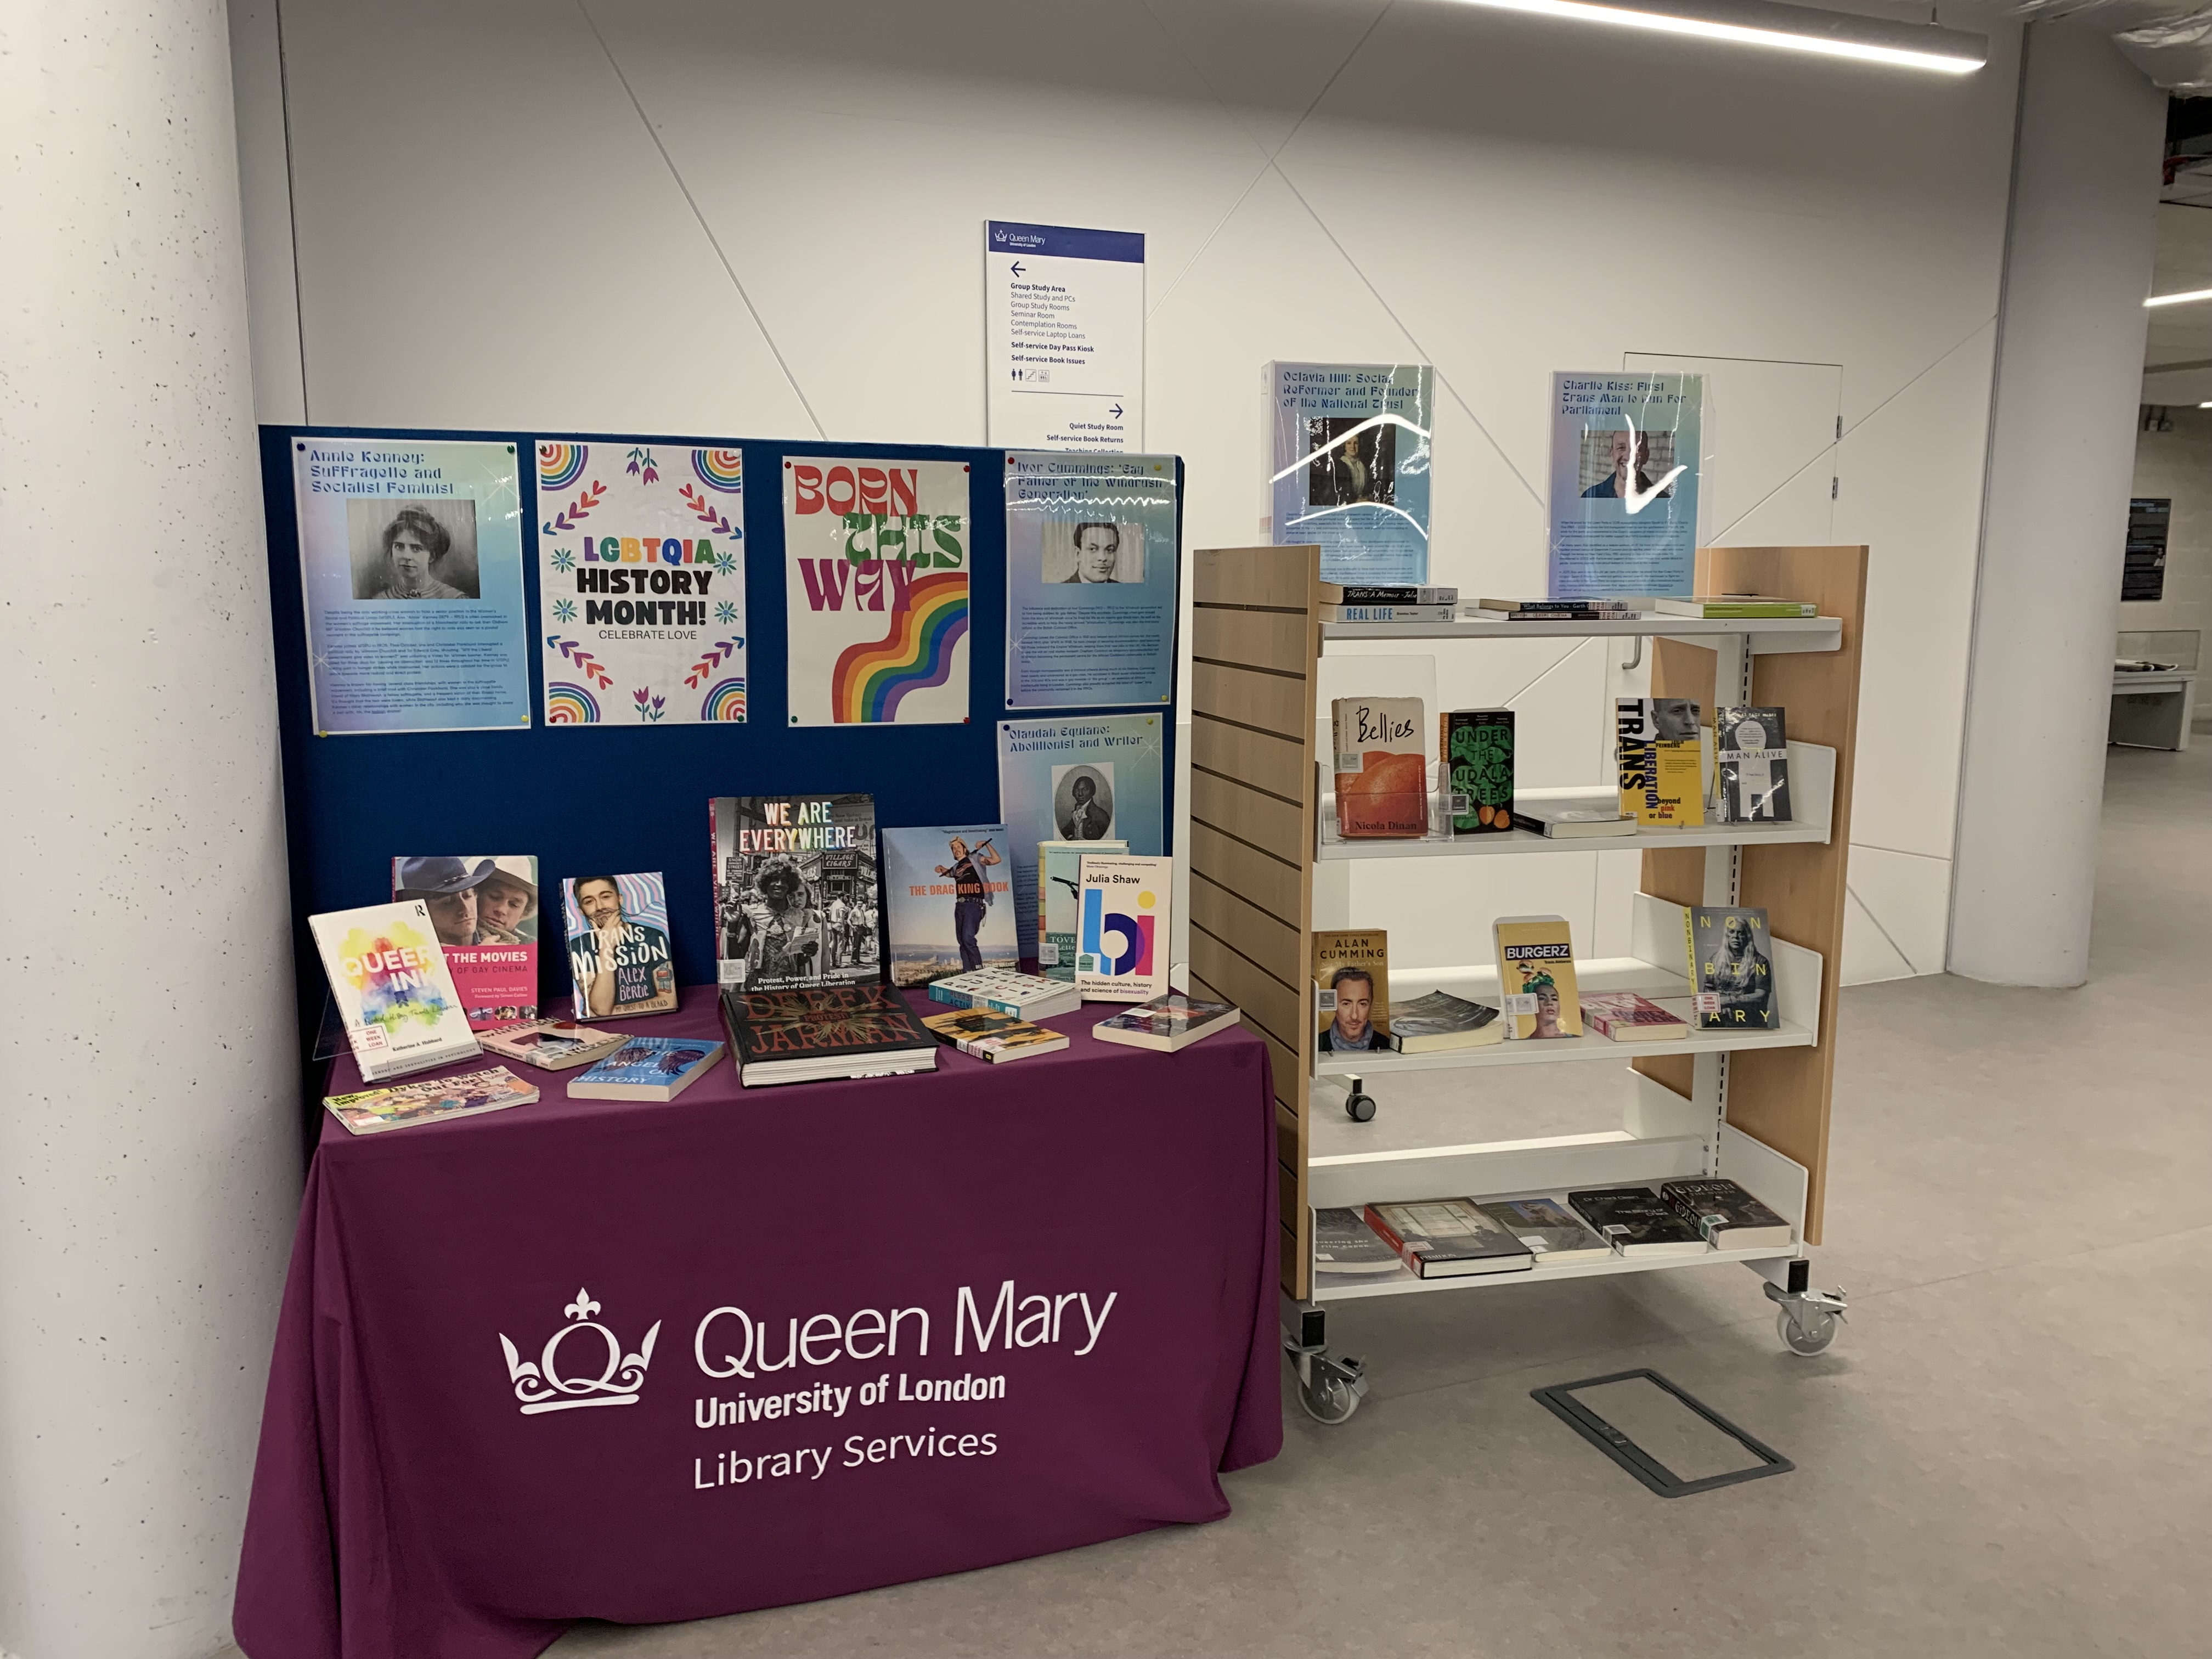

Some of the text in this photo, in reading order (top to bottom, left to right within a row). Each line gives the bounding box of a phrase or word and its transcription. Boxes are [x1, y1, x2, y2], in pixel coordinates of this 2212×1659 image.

[1009, 233, 1046, 245] Queen Mary
[1011, 283, 1030, 291] Group
[1032, 284, 1050, 292] Study
[1011, 291, 1032, 300] Shared
[1034, 293, 1051, 302] Study
[1011, 301, 1029, 309] Group
[1031, 302, 1048, 311] Study
[1011, 319, 1056, 328] Contemplation
[1011, 329, 1045, 337] Self-service
[1046, 330, 1067, 339] Laptop
[1011, 341, 1048, 349] Self-service
[1011, 354, 1048, 363] Self-service
[1284, 371, 1351, 383] Octavia Hill:
[1345, 386, 1365, 396] and
[1563, 380, 1664, 391] Charlie Kiss: First
[1301, 398, 1368, 409] the National
[1563, 393, 1637, 403] Trans Man to
[1562, 404, 1621, 415] Parliament
[311, 450, 425, 465] Annie Kenney:
[414, 468, 441, 479] and
[1018, 462, 1114, 475] Ivor Cummings:
[312, 481, 453, 494] Socialist Feminist
[794, 465, 918, 517] BORN
[843, 512, 963, 569] THIS
[584, 537, 715, 566] LGBTQIA
[576, 567, 713, 595] HISTORY
[797, 558, 918, 612] WAY
[585, 599, 706, 626] MONTH!
[1346, 607, 1393, 620] REAL LIFE
[599, 630, 697, 640] CELEBRATE LOVE
[1356, 706, 1414, 743] Bellies
[1009, 725, 1110, 740] Olaudah Equiano:
[1455, 729, 1509, 744] UNDER
[1010, 735, 1143, 752] Abolitionist and Writer
[1618, 699, 1646, 790] TRANS
[1471, 749, 1494, 761] THE
[1726, 750, 1783, 760] MAN ALIVE
[1455, 769, 1509, 782] UDALA
[1644, 740, 1658, 809] LIBERATION
[1455, 786, 1509, 801] TREES
[1657, 797, 1681, 806] beyond
[764, 802, 833, 826] WE ARE
[1355, 821, 1417, 831] Nicola Dinan
[740, 826, 856, 853] EVERYWHERE
[1086, 874, 1140, 884] Julia Shaw
[909, 882, 1009, 896] THE DRAG KING BOOK
[584, 923, 645, 951] TRANS
[1083, 888, 1155, 977] bi
[1335, 939, 1369, 948] ALAN
[452, 951, 528, 963] THE MOVIES
[1320, 949, 1384, 959] CUMMING
[1507, 945, 1569, 959] BURGERZ
[342, 946, 436, 977] QUEER
[493, 965, 528, 973] CINEMA
[737, 985, 901, 1019] DEREK
[751, 1014, 921, 1054] JARMAN
[392, 1042, 416, 1052] Katherine
[387, 1082, 432, 1093] Dykes
[456, 1068, 499, 1080] Watch
[421, 1077, 477, 1092] Out For
[334, 1089, 383, 1106] Improved!
[695, 1280, 1117, 1378] Queen Mary
[695, 1373, 1006, 1429] University of London
[694, 1426, 998, 1490] Library Services
